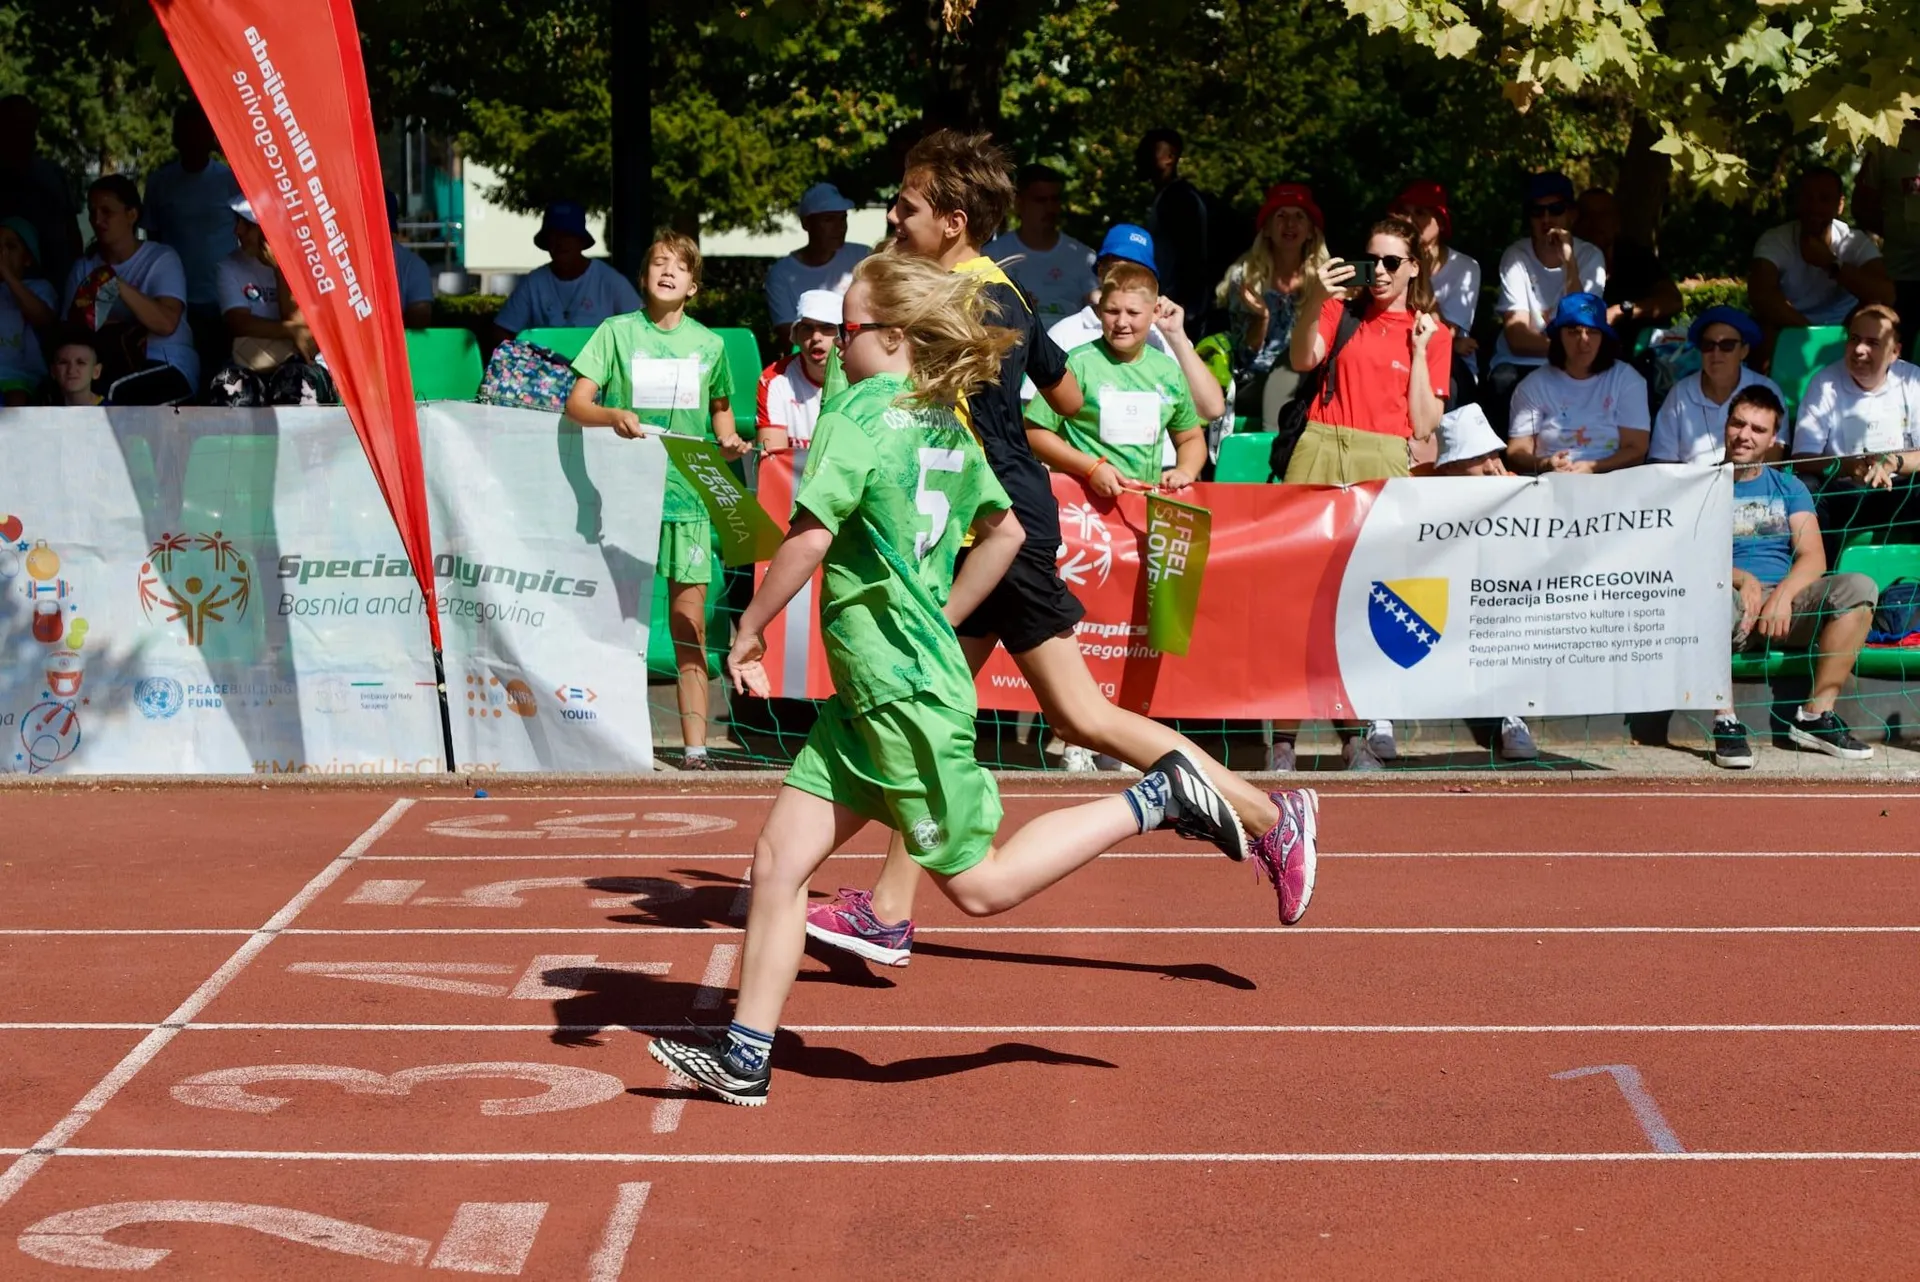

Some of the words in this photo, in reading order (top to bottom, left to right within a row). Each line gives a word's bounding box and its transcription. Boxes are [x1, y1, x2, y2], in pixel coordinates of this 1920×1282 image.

[705, 465, 743, 502] FEEL
[682, 452, 751, 545] SLOVENIA
[913, 447, 965, 562] 5
[1177, 508, 1194, 522] I
[1417, 516, 1540, 542] PONOSNI
[1547, 508, 1674, 538] PARTNER
[1147, 504, 1172, 606] SLOVE
[1163, 524, 1193, 580] FEEL
[276, 554, 416, 586] Specia
[434, 553, 599, 599] Olympics
[1470, 578, 1532, 593] BOSNA
[1537, 579, 1542, 591] I
[1546, 570, 1674, 590] HERCEGOVINA
[278, 590, 360, 617] Bosnia
[366, 588, 414, 616] and
[1470, 594, 1541, 608] Federacija
[1545, 593, 1589, 604] Bosne
[1601, 587, 1686, 602] Hercegovine
[1469, 614, 1522, 626] Federalno
[1524, 610, 1587, 623] ministarstvo
[1590, 608, 1625, 620] kulture
[1633, 607, 1665, 620] sporta
[1072, 621, 1148, 639] ympics
[1469, 629, 1522, 641] Federalno
[1524, 625, 1587, 638] ministarstvo
[1590, 623, 1625, 635] kulture
[1633, 622, 1665, 635] športa
[1655, 638, 1662, 647] и
[1664, 635, 1699, 648] спорта
[1469, 657, 1509, 668] Federal
[1511, 655, 1552, 667] Ministry
[1555, 654, 1566, 665] of
[1568, 652, 1606, 664] Culture
[1608, 651, 1629, 663] and
[1631, 650, 1664, 663] Sports
[187, 684, 293, 696] PEACEBUILDING
[360, 692, 390, 701] Embassy
[188, 698, 222, 708] FUND
